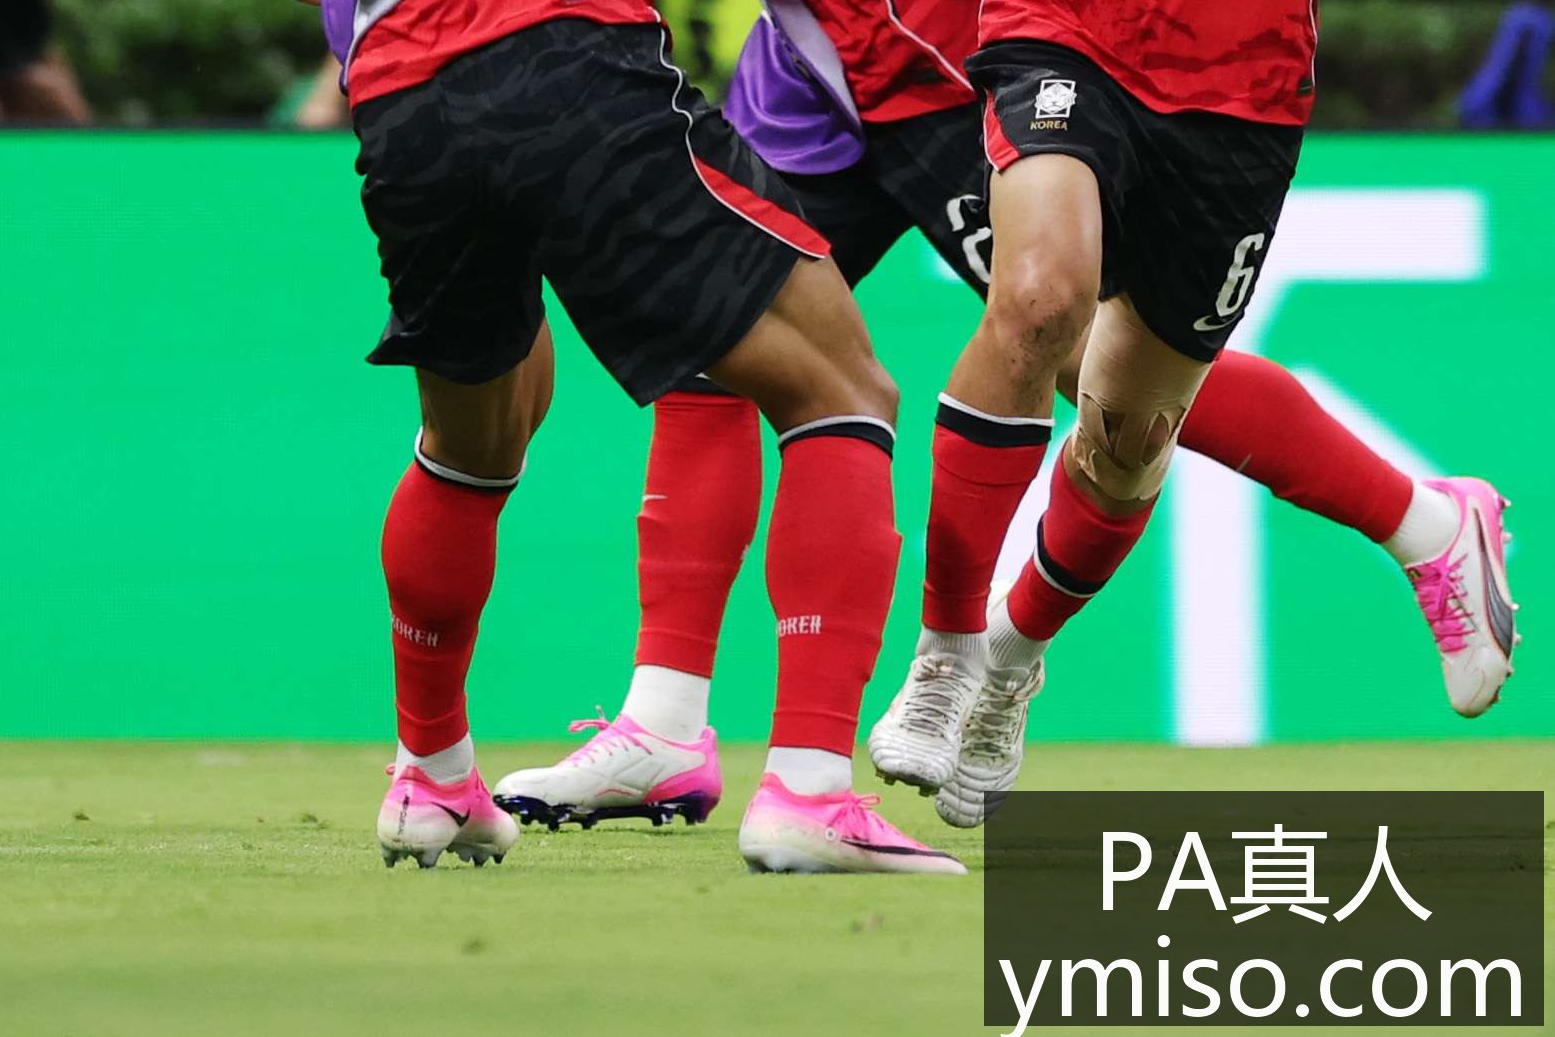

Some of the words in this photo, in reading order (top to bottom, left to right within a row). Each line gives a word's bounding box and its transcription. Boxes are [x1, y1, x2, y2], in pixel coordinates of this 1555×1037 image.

[1029, 120, 1069, 131] KOREA
[1215, 232, 1266, 318] 6
[390, 615, 439, 648] OREA
[776, 614, 822, 637] OREA
